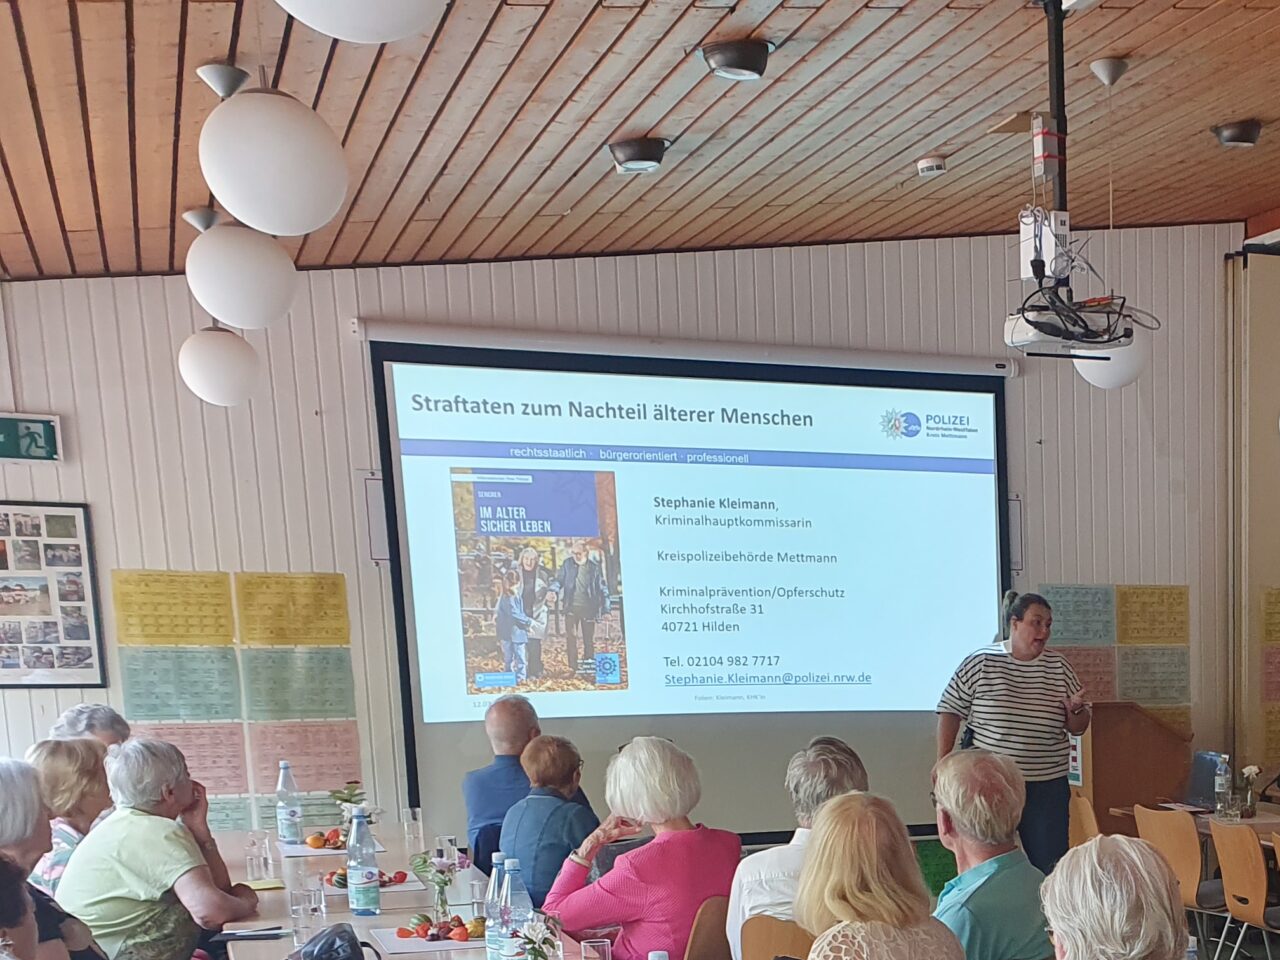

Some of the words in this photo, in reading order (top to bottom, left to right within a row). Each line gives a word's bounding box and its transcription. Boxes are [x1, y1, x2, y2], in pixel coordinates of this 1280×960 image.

[411, 393, 515, 415] Straftaten
[520, 402, 563, 417] zum
[568, 401, 648, 421] Nachteil
[653, 404, 716, 423] älterer
[721, 407, 814, 427] Menschen
[925, 414, 970, 426] POLIZEI
[509, 447, 587, 459] rechtsstaatlich
[599, 448, 678, 462] bürgerorientiert
[686, 452, 749, 465] professionell
[653, 496, 716, 510] Stephanie
[719, 498, 779, 512] Kleimann,
[480, 506, 492, 519] IM
[496, 507, 527, 519] ALTER
[481, 519, 517, 533] SICHER
[520, 520, 552, 533] LEBEN
[655, 514, 813, 529] Kriminalhauptkommissarin
[657, 550, 774, 564] Kreispolizeibehörde
[777, 552, 838, 564] Mettmann
[659, 585, 845, 600] Kriminalprävention/Opferschutz
[660, 603, 747, 615] Kirchhofstraße
[750, 604, 765, 615] 31
[661, 621, 699, 632] 40721
[702, 620, 741, 632] Hilden
[663, 656, 684, 667] Tel.
[687, 655, 724, 667] 02104
[727, 655, 749, 667] 982
[752, 655, 781, 666] 7717
[664, 671, 873, 687] Stephanie.Kleimann@polizei.nrw.de
